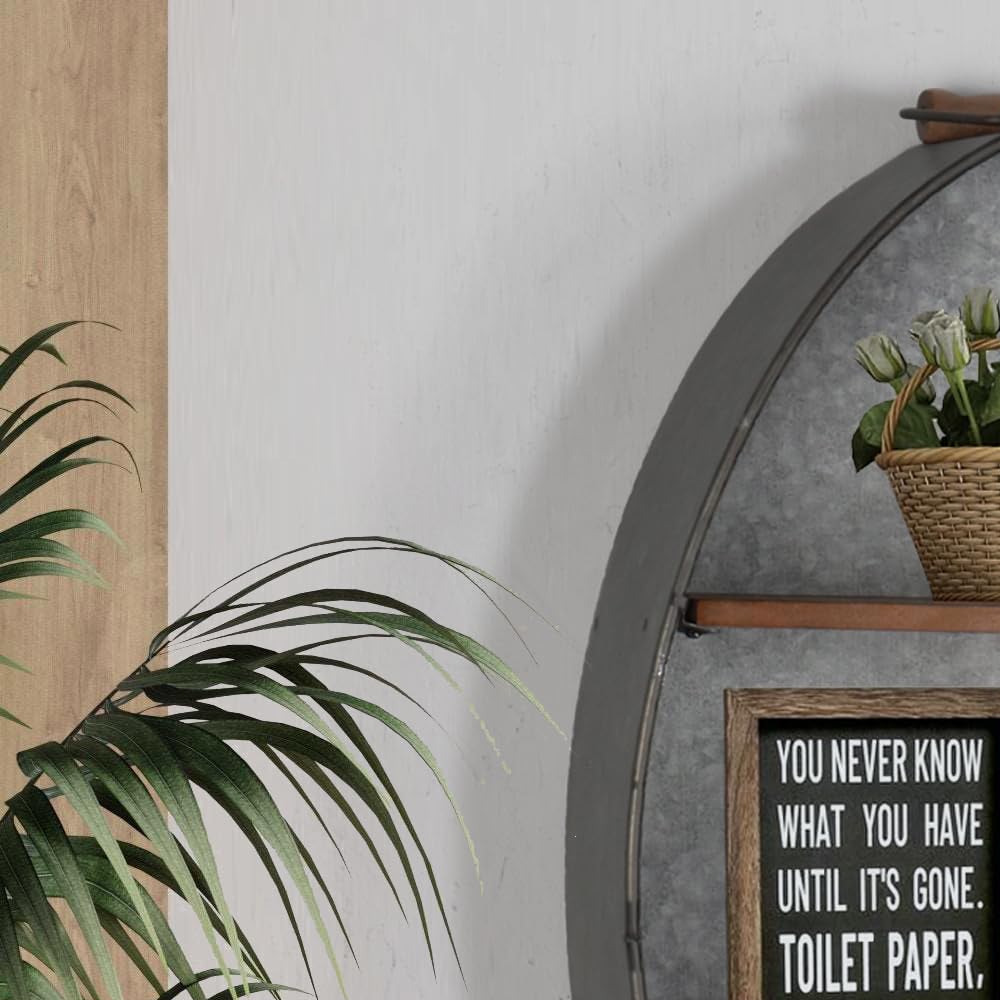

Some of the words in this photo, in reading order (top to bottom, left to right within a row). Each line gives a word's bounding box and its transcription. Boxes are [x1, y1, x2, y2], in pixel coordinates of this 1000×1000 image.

[776, 739, 823, 784] YOU
[831, 738, 908, 784] NEVER
[914, 738, 984, 783] KNOW
[777, 804, 846, 849] WHAT
[862, 803, 908, 848] YOU
[924, 802, 984, 847] HAVE
[778, 867, 848, 913] UNTIL
[860, 867, 900, 912] IT'S
[912, 866, 984, 911] GONE.
[779, 932, 875, 994] TOILET
[888, 930, 984, 991] PAPER,
